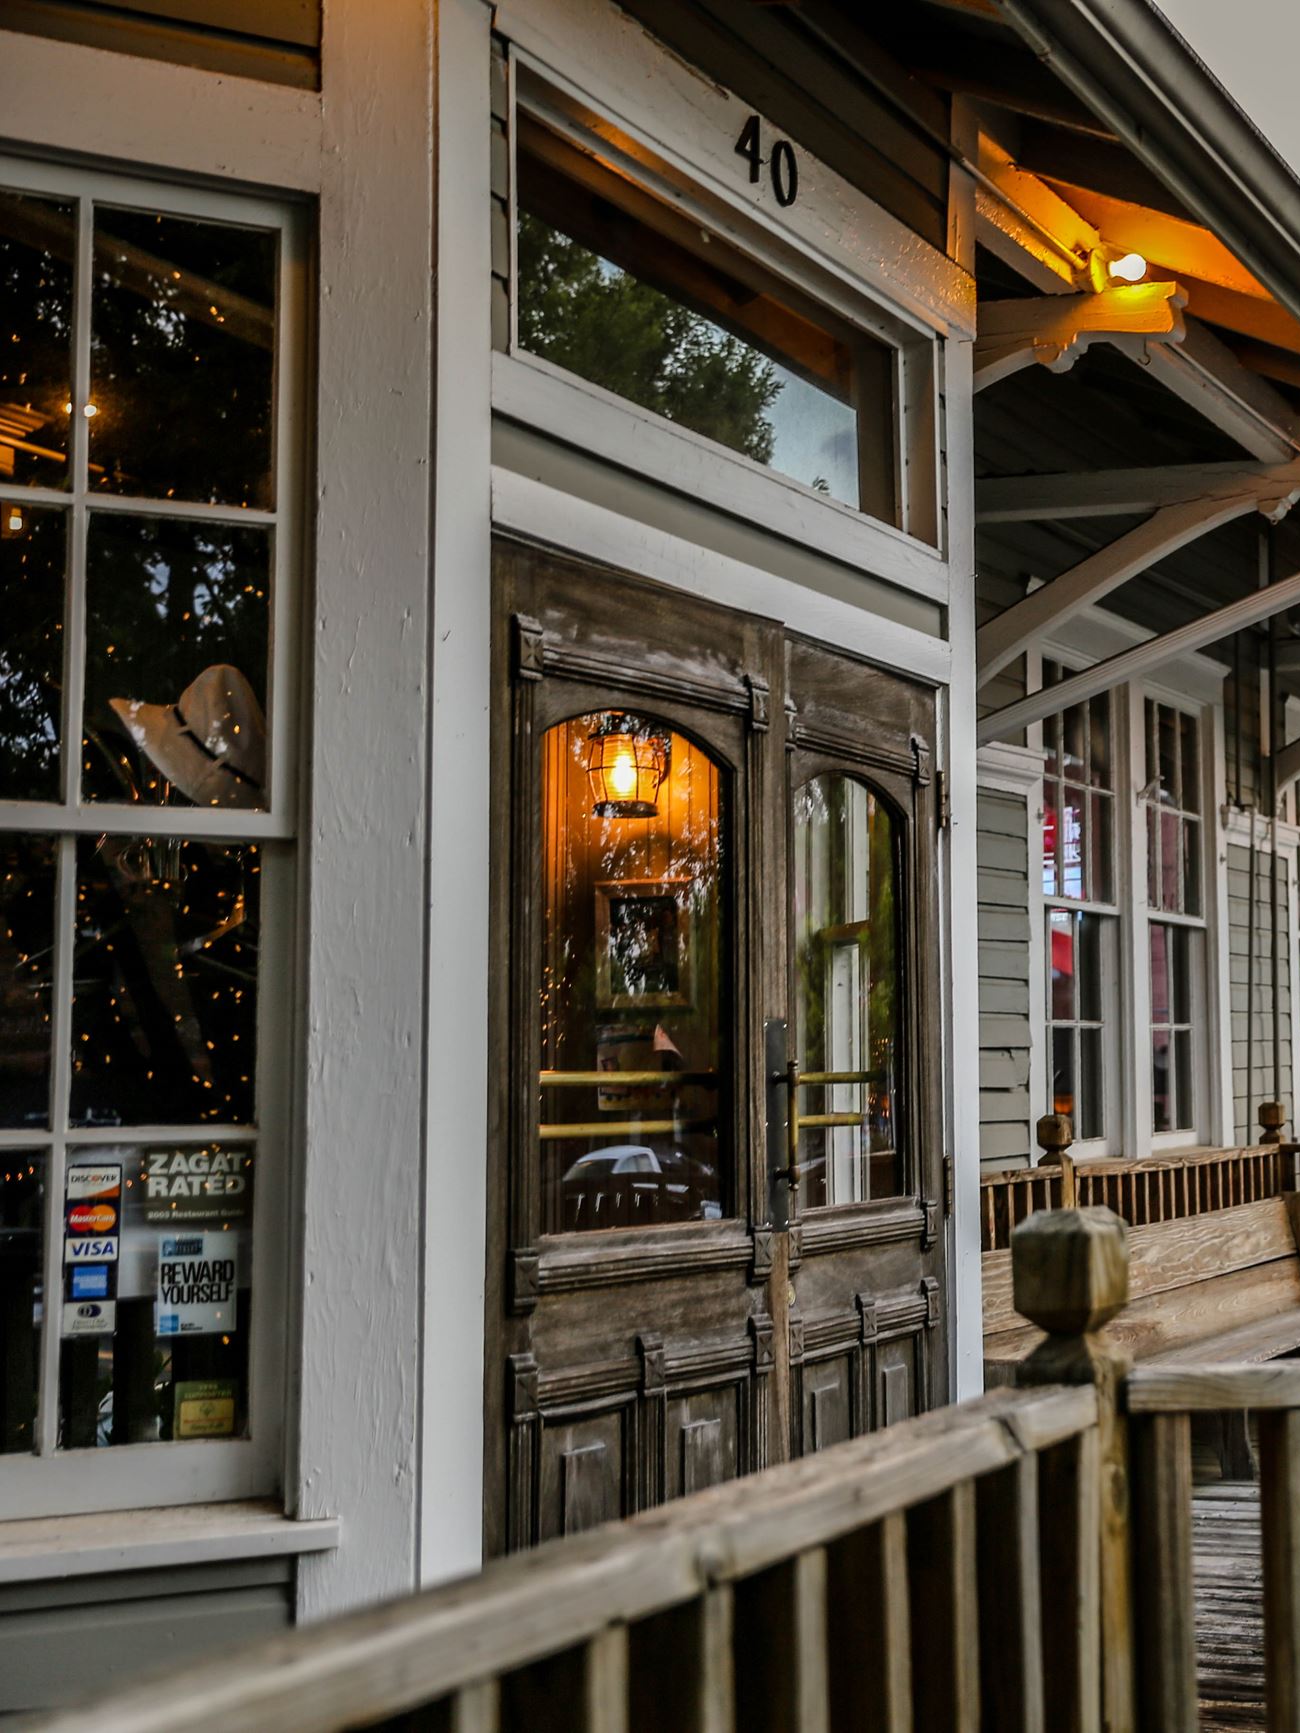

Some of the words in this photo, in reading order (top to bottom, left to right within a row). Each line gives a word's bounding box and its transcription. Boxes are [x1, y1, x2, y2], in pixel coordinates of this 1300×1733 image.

[734, 115, 798, 207] 40
[148, 1151, 247, 1175] ZAGAT
[70, 1174, 118, 1184] DISCOVER
[147, 1174, 246, 1198] RATED
[70, 1213, 117, 1225] MasterCard
[71, 1240, 115, 1257] VISA
[161, 1260, 235, 1285] REWARD
[161, 1282, 234, 1305] YOURSELF
